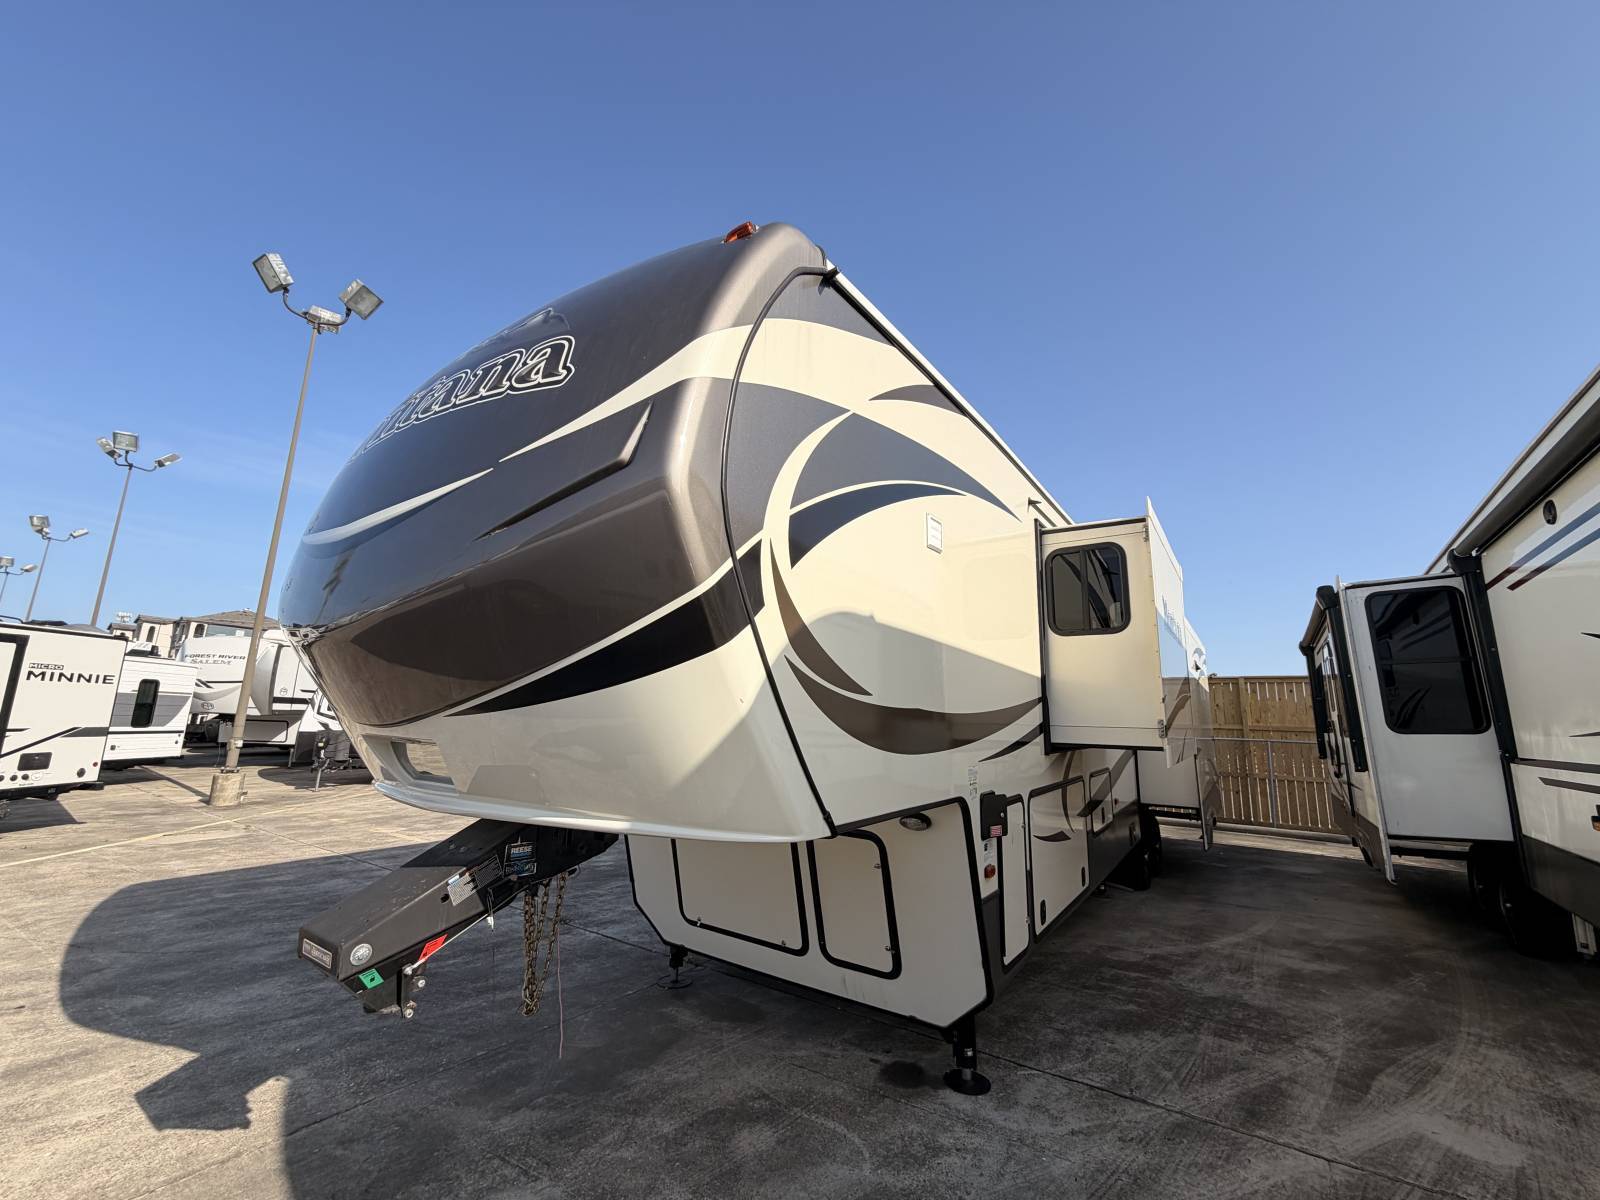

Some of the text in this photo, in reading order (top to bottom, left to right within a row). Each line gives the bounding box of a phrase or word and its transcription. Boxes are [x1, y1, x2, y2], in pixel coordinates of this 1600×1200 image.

[353, 335, 576, 456] ntana
[29, 662, 64, 670] MICRO
[26, 670, 115, 684] MINNIE
